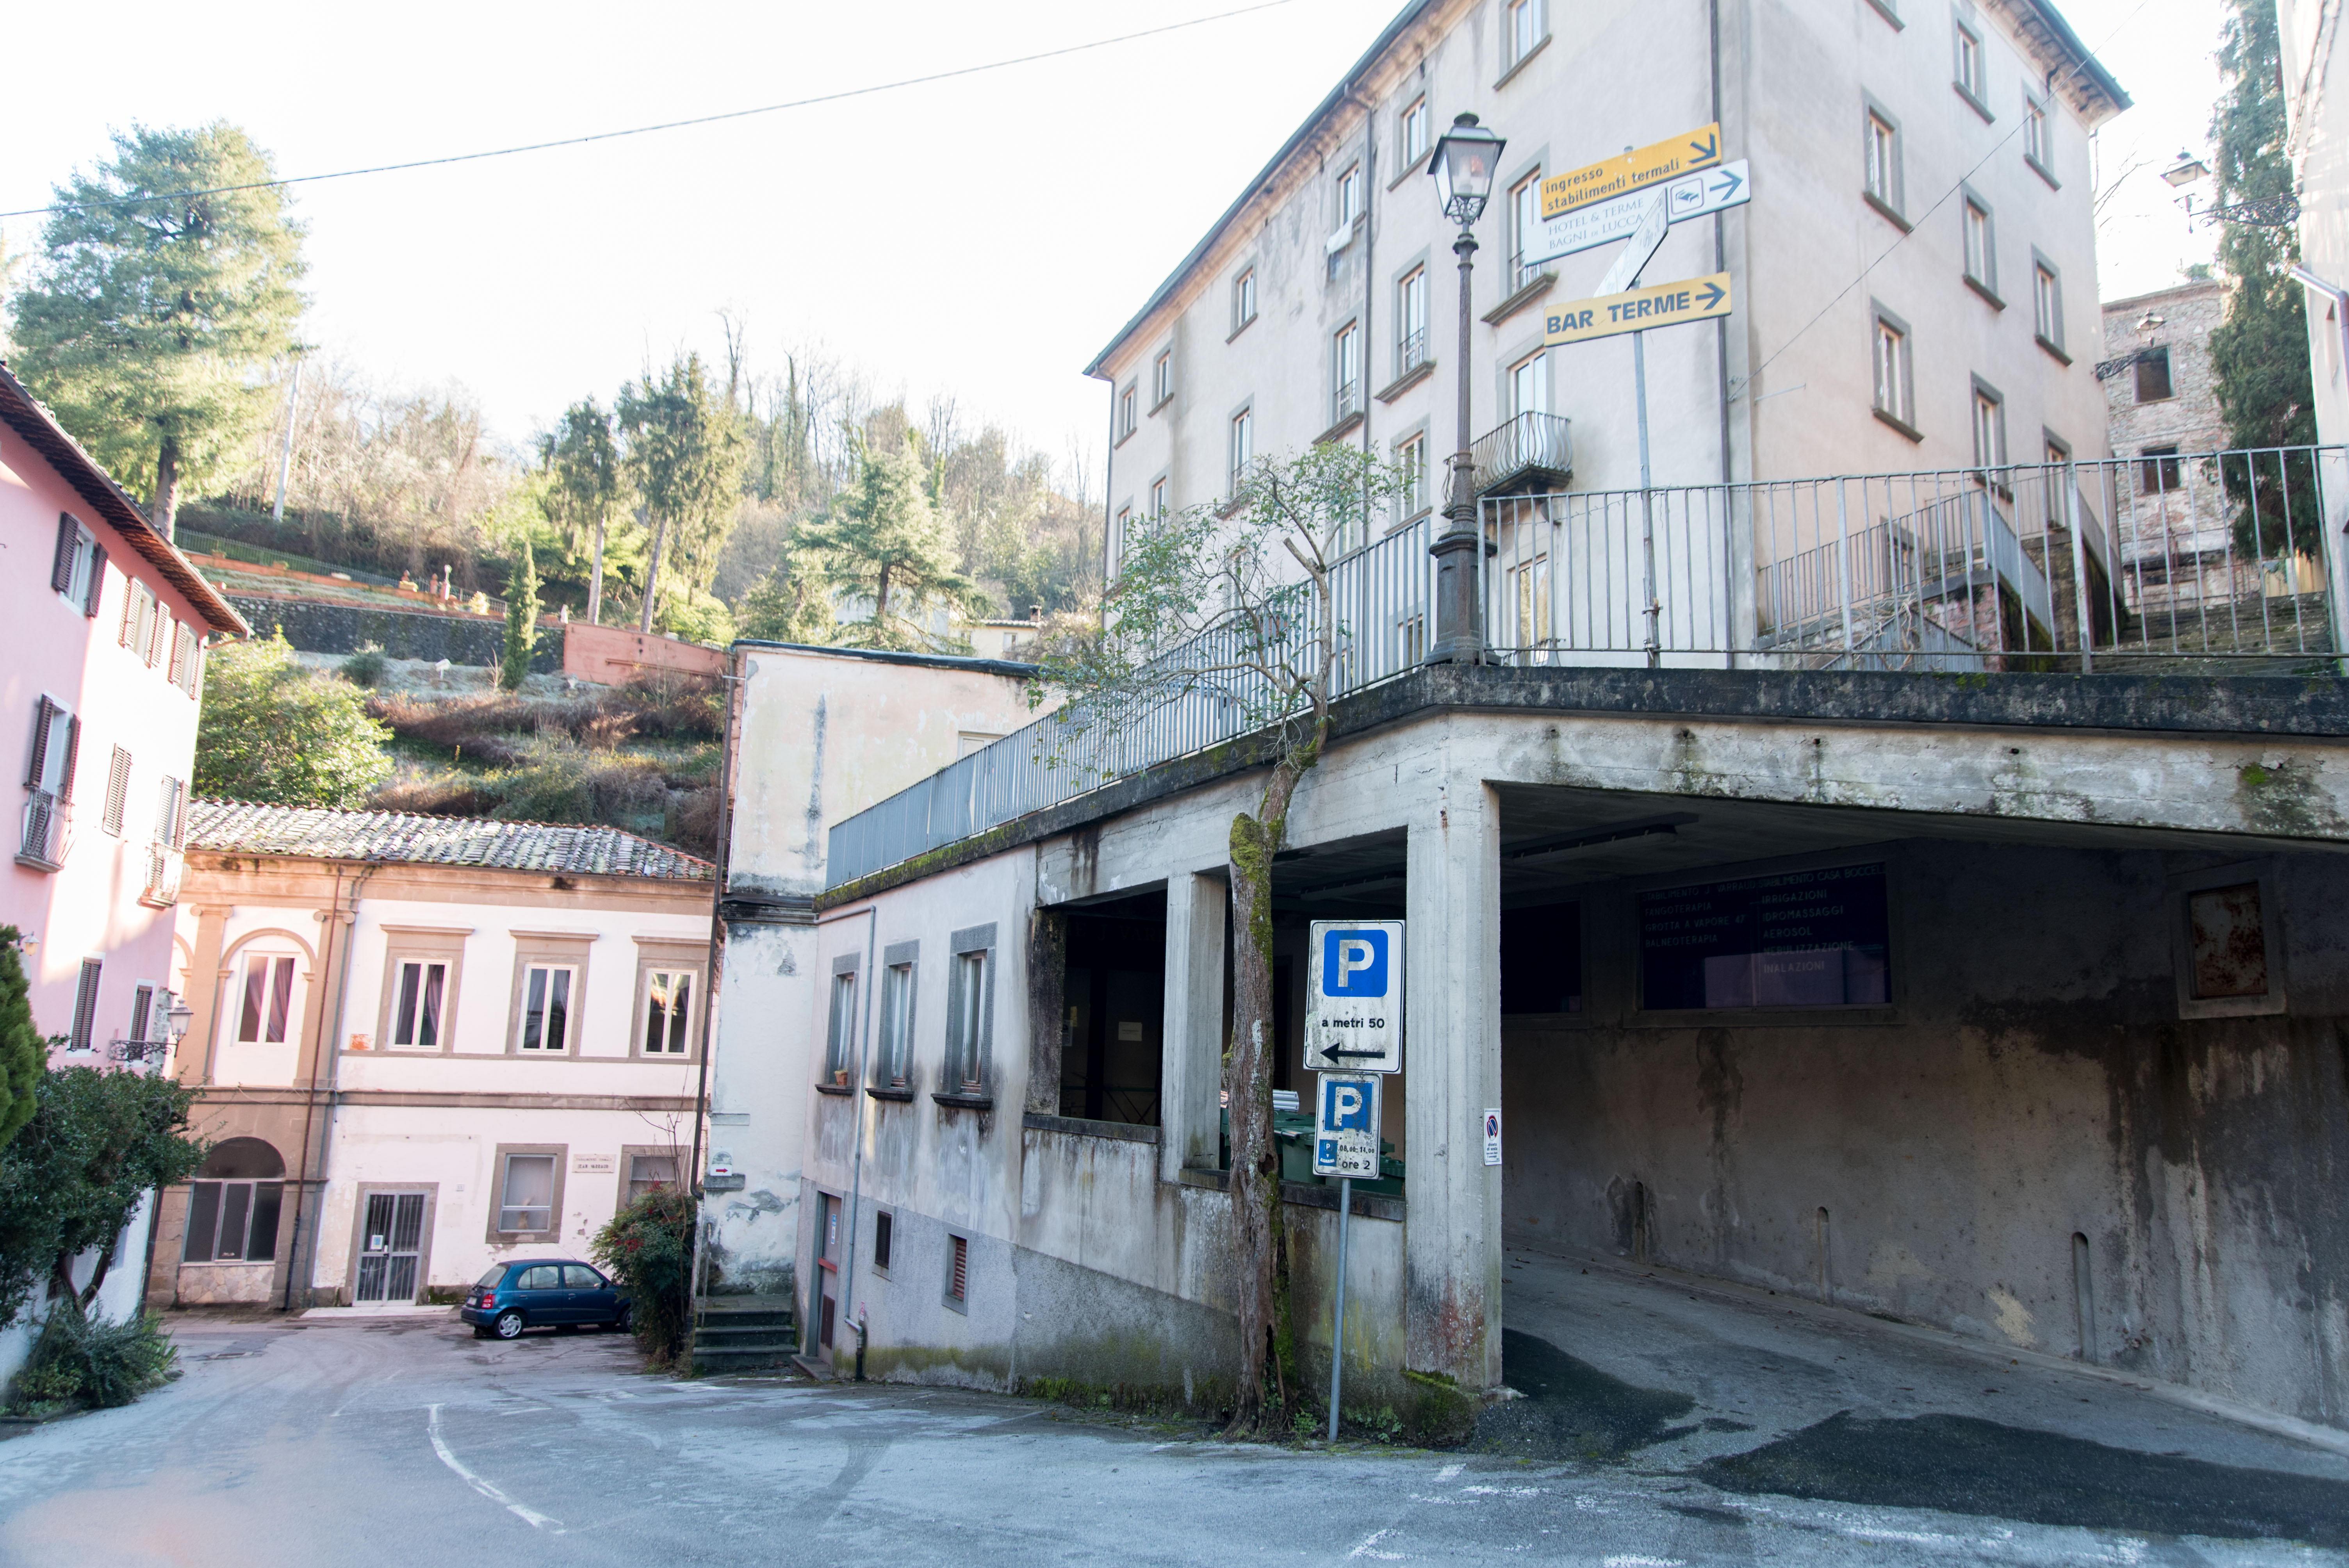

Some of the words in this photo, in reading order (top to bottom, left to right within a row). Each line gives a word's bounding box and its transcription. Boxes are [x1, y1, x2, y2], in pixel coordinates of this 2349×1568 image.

[1545, 168, 1603, 194] ingresso
[1548, 175, 1626, 211] stabilimenti
[1632, 157, 1680, 183] termali
[1549, 216, 1588, 236] HOTEL
[1591, 212, 1600, 222] &
[1602, 198, 1644, 219] TERME
[1549, 230, 1587, 250] BAGNI
[1602, 213, 1643, 234] LUCCA
[1547, 310, 1594, 335] BAR
[1607, 290, 1690, 323] TERME
[1818, 870, 1841, 881] CASA
[1643, 888, 1699, 901] STABILIMENTO
[1717, 880, 1756, 893] VARRAUD
[1761, 889, 1827, 904] IRRIGAZIONI
[1645, 902, 1712, 916] FANGOTERAPIA
[1762, 905, 1843, 922] IDROMASSAGGI
[1645, 921, 1681, 932] GROTTA
[1684, 920, 1691, 929] A
[1693, 916, 1730, 928] VAPORE
[1763, 926, 1813, 939] AEROSOL
[1645, 935, 1718, 948] BALNEOTERAPIA
[1763, 941, 1854, 955] NEBULIZZAZIONE
[1338, 939, 1375, 987] P
[1764, 960, 1825, 973] INALAZIONI
[1321, 1019, 1329, 1027] a
[1333, 1017, 1364, 1028] metri
[1369, 1018, 1385, 1028] 50
[1334, 1087, 1362, 1127] P
[1342, 1160, 1359, 1169] ore
[1363, 1160, 1370, 1170] 2
